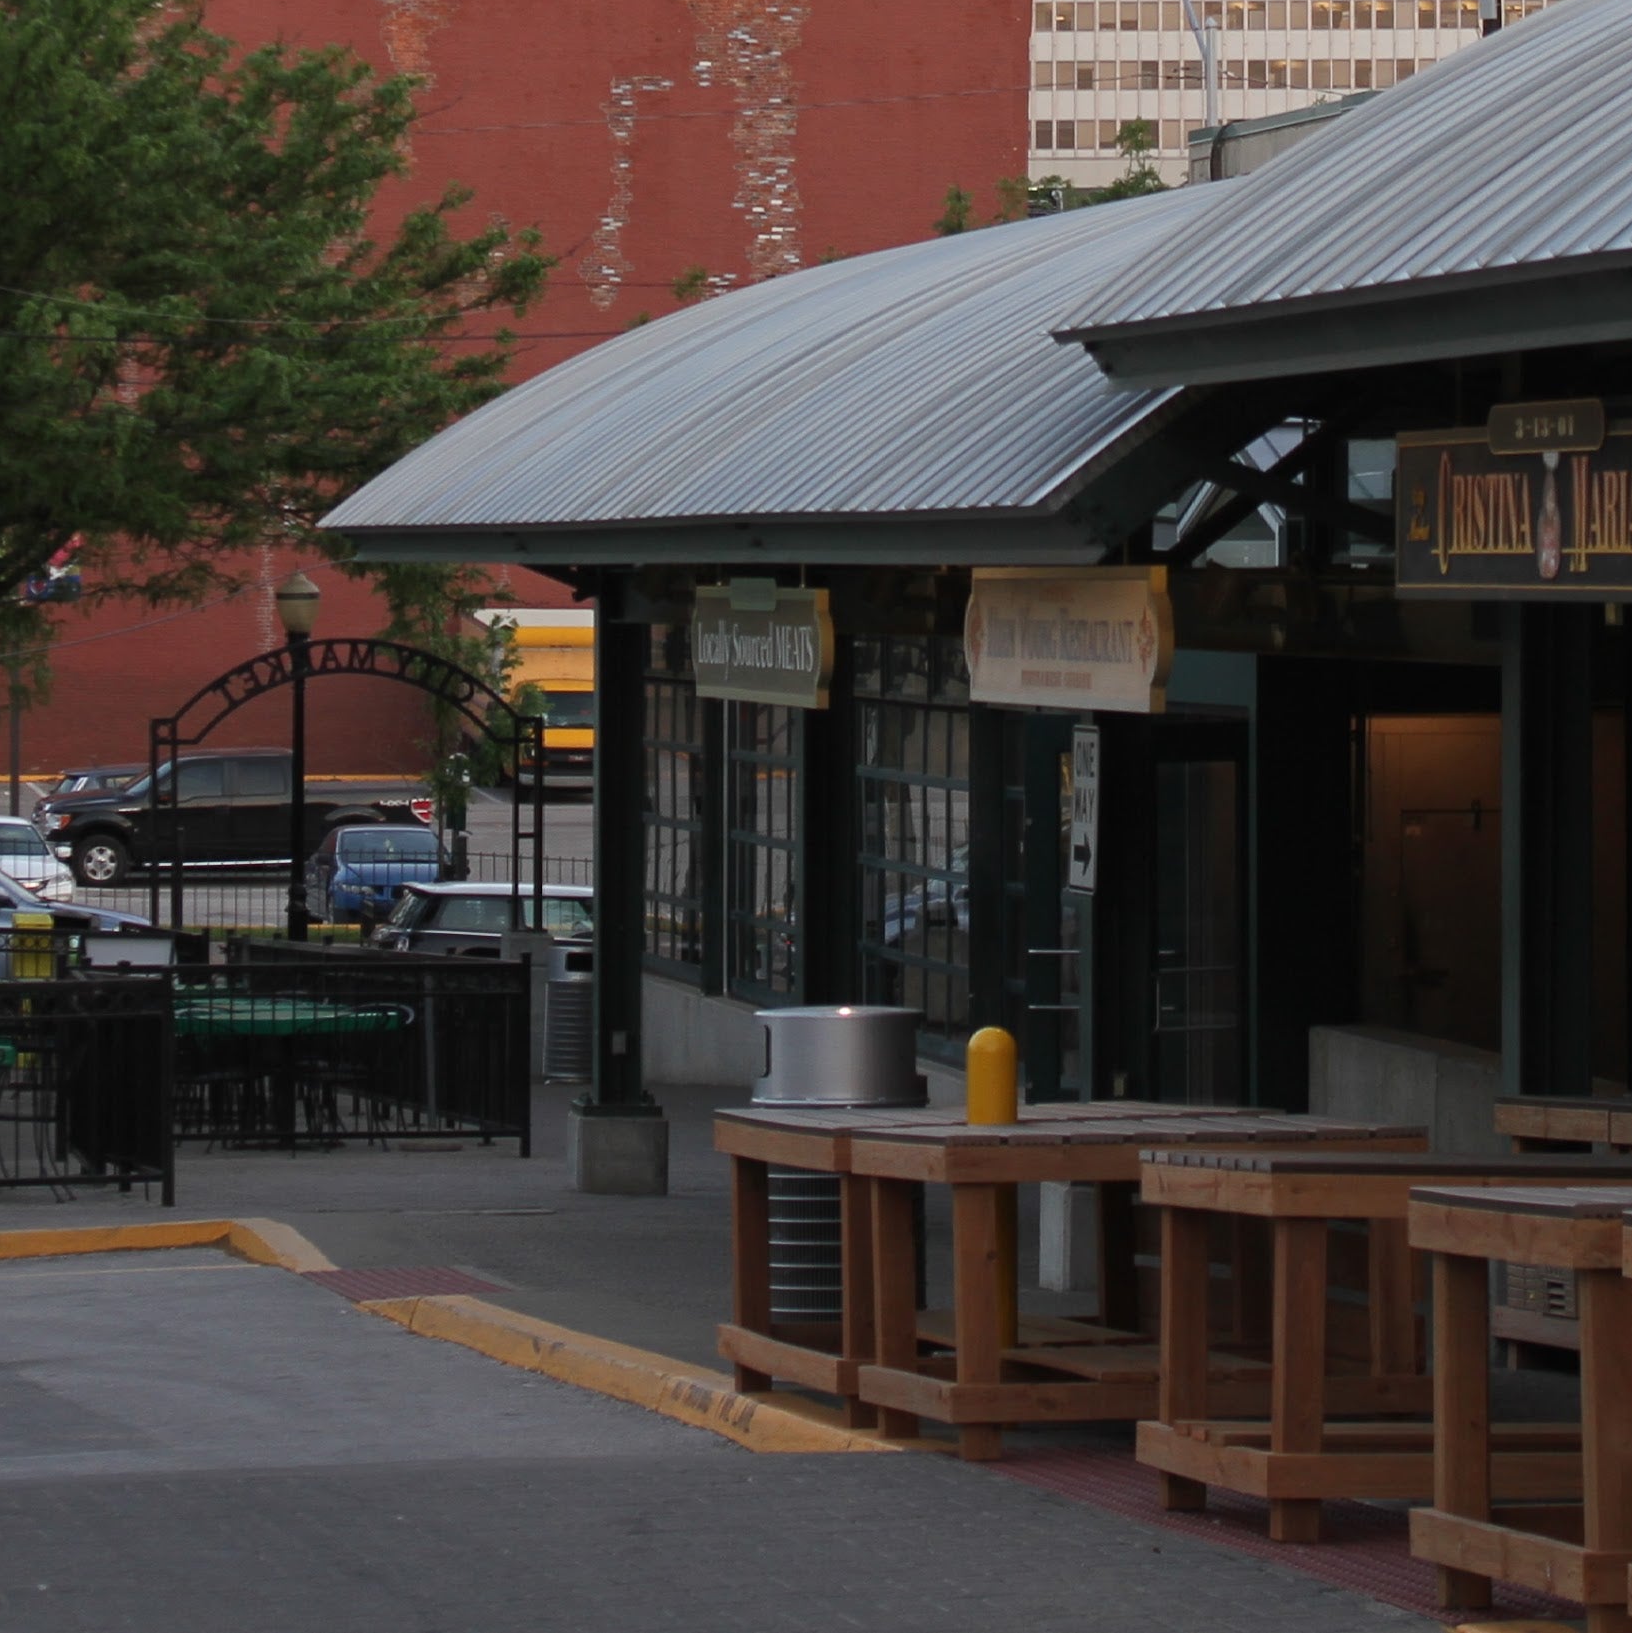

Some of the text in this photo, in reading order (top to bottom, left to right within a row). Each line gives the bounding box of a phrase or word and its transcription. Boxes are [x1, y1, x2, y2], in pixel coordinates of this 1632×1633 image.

[698, 619, 814, 681] Locally Sourced MEATS
[1076, 741, 1095, 778] ONE
[1074, 787, 1095, 824] WAY
